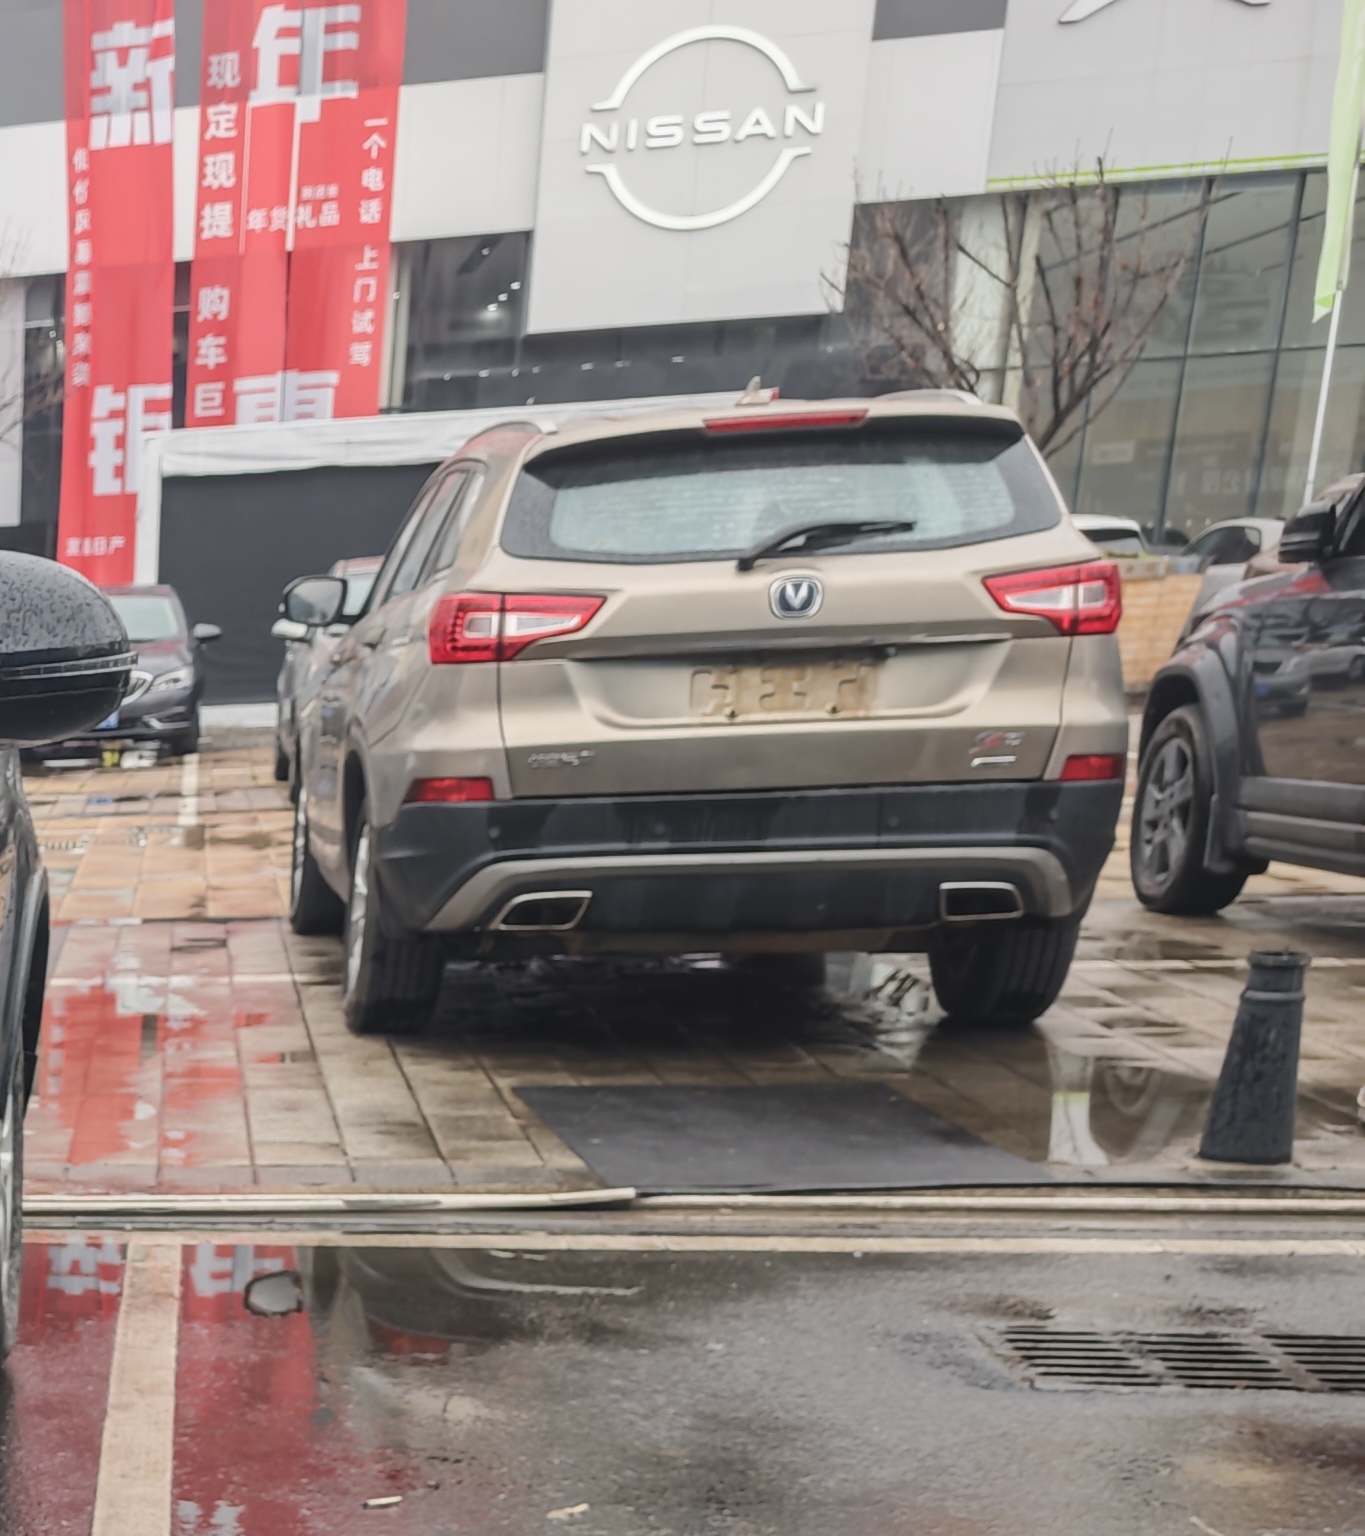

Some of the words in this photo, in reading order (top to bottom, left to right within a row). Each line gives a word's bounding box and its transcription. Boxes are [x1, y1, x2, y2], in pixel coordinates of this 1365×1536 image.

[248, 3, 362, 124] 年
[358, 116, 390, 225] 一个电话
[579, 100, 826, 156] NISSAN
[349, 244, 379, 367] 上门试驾
